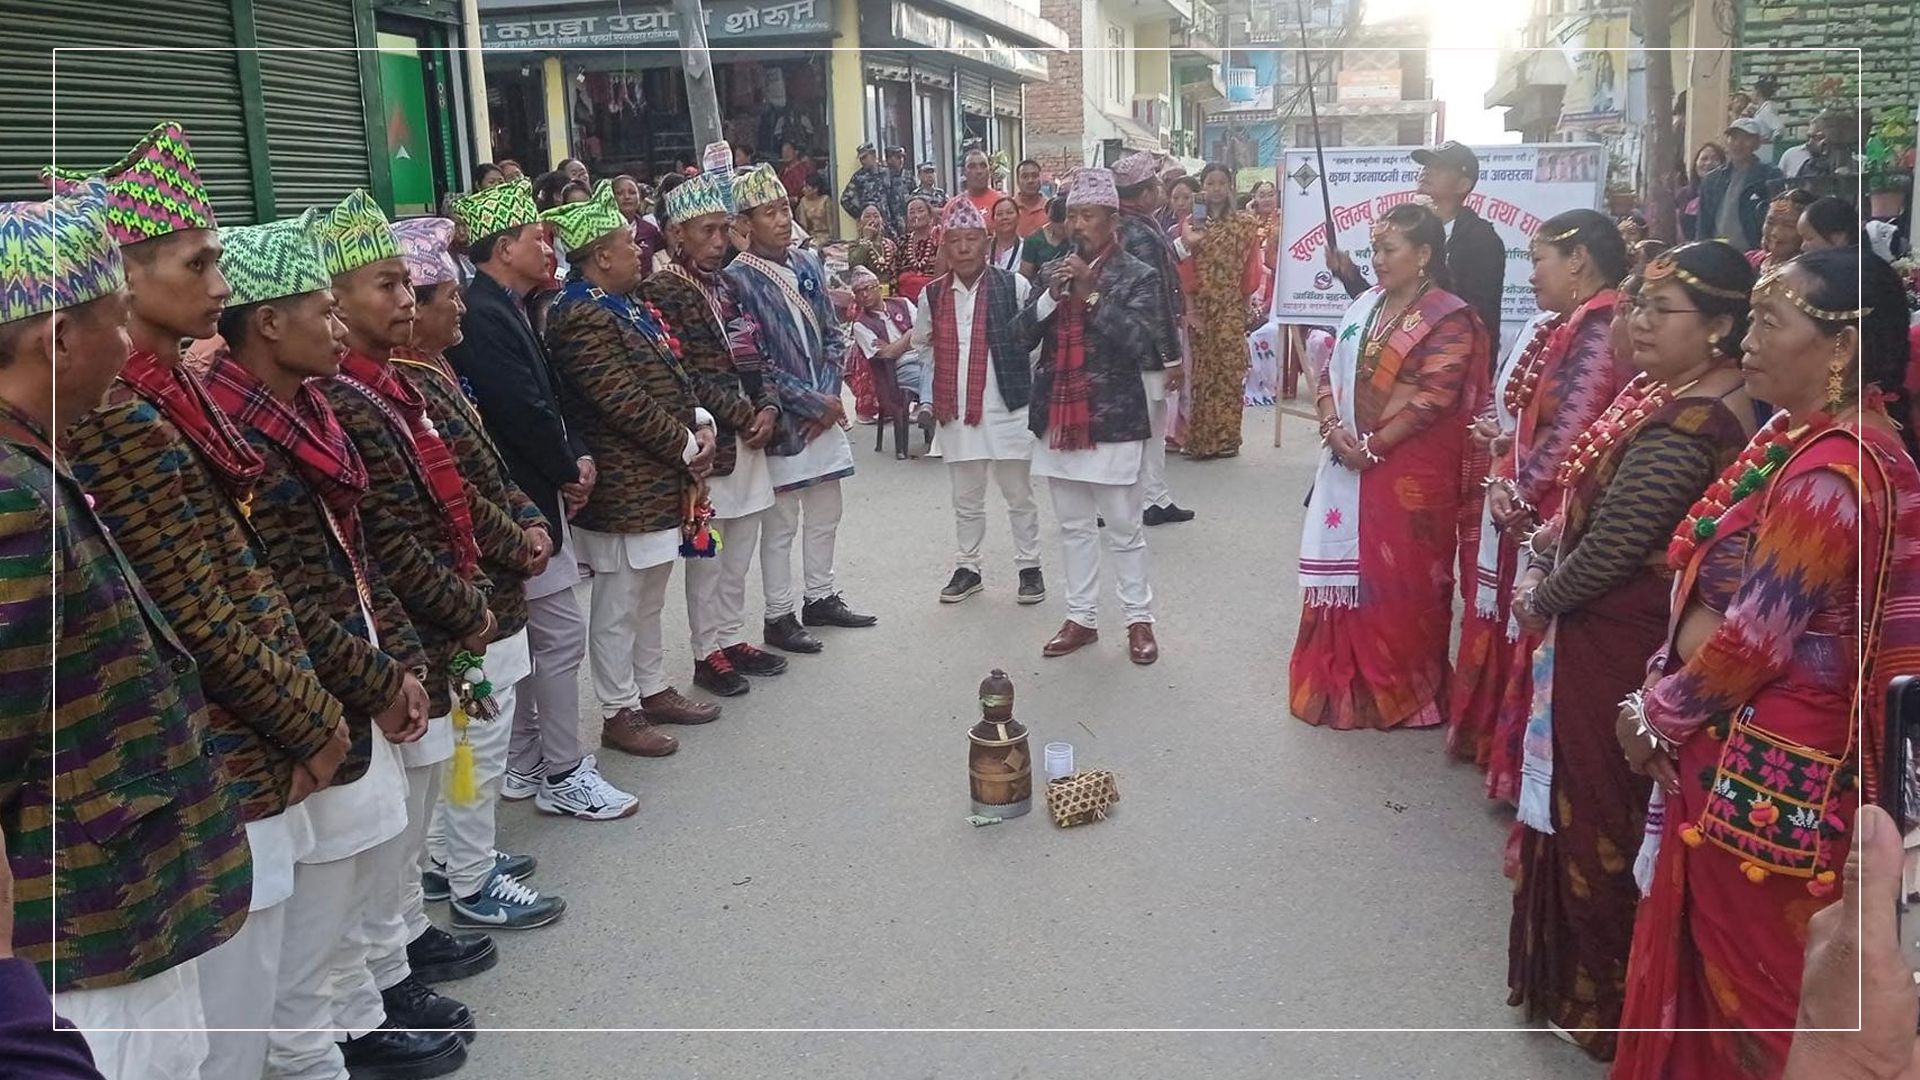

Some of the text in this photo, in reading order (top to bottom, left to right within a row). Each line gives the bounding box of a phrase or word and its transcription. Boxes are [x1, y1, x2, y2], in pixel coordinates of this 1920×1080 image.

[1328, 171, 1351, 186] कृष्ण
[1490, 168, 1534, 182] अवसरमा
[1487, 198, 1521, 227] तथा
[1288, 222, 1331, 262] खुल्ल
